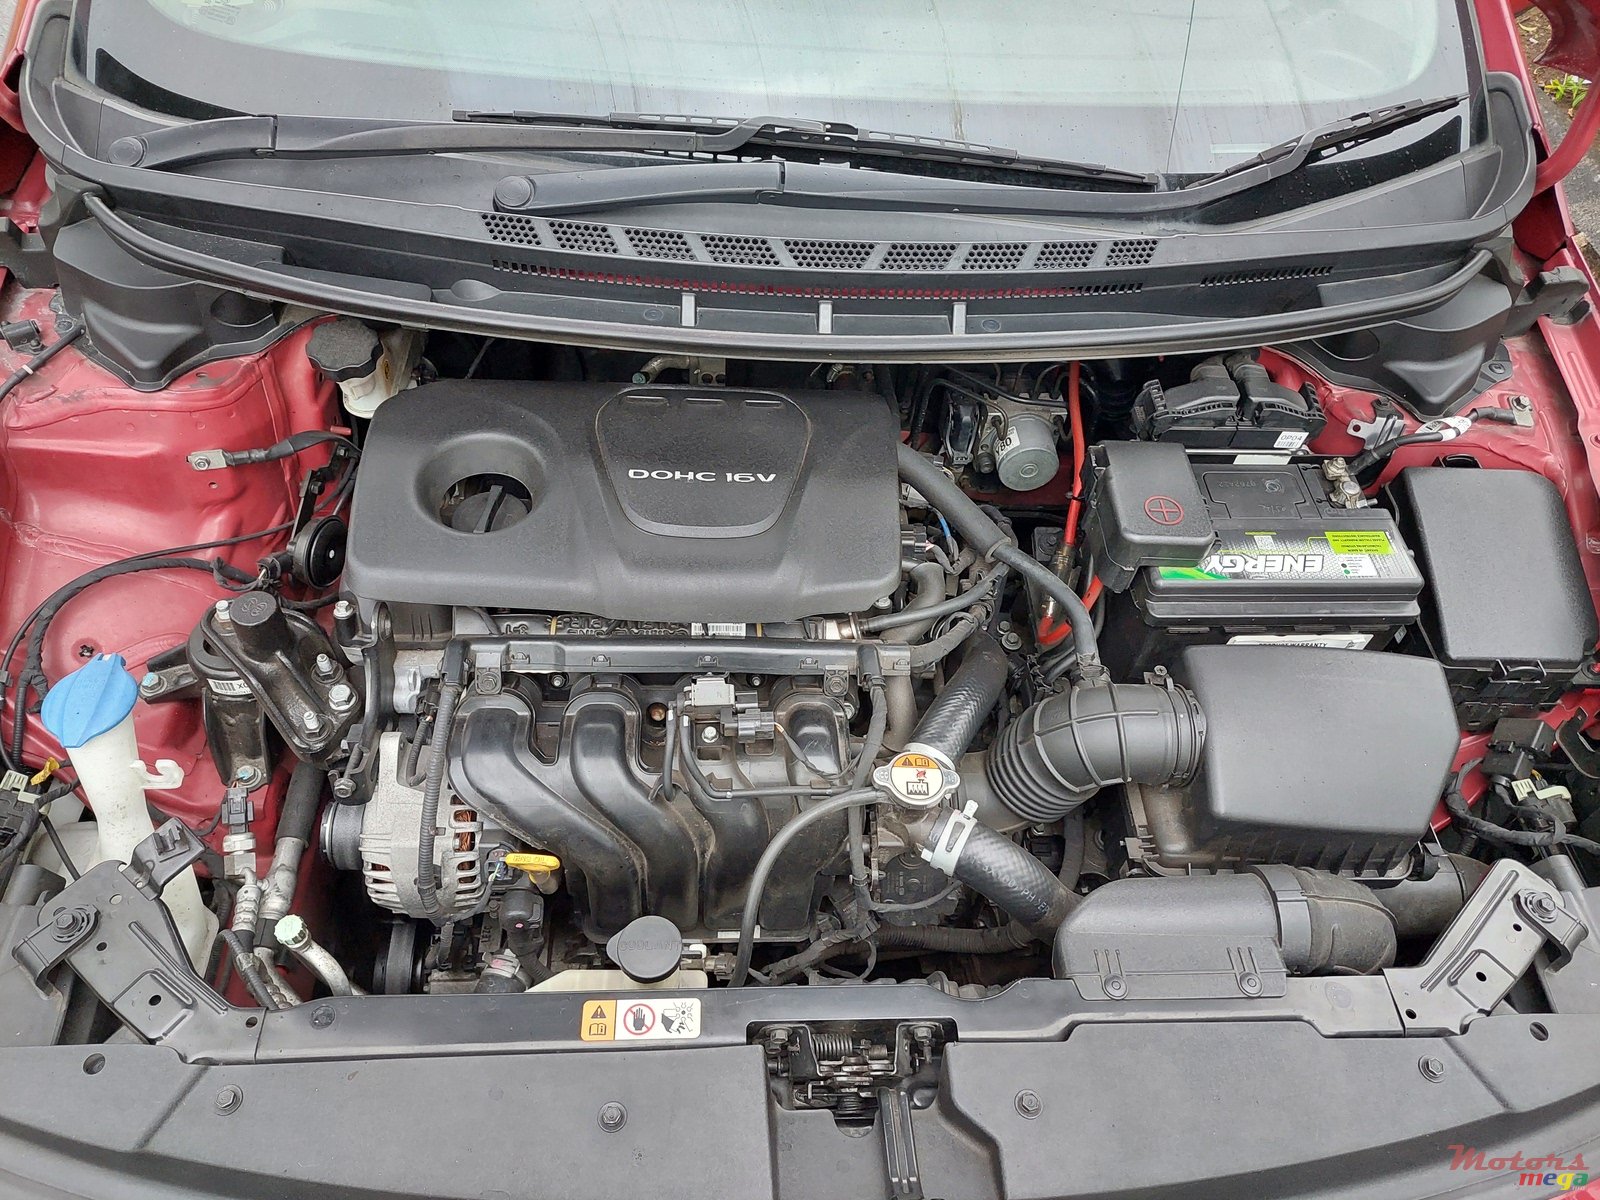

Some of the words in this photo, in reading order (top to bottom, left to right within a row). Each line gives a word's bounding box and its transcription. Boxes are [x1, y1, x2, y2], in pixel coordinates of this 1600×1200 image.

[628, 468, 716, 482] DOHC
[725, 472, 777, 483] 16V
[1203, 553, 1325, 573] ENERGY
[619, 939, 682, 952] COOLANT
